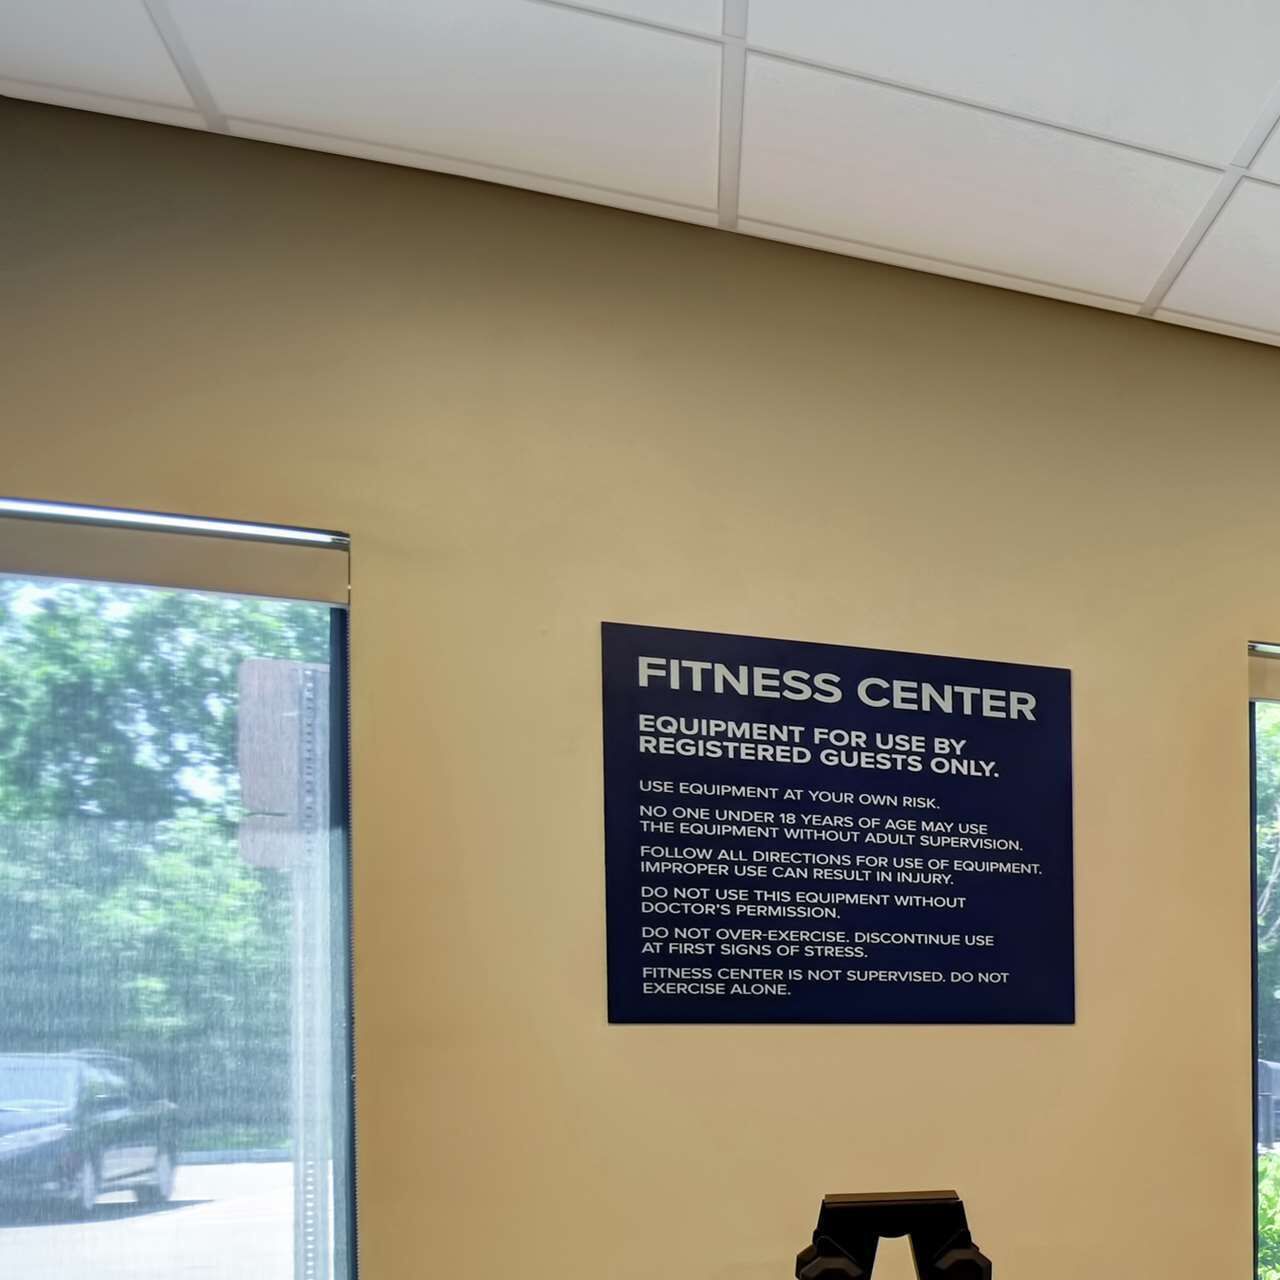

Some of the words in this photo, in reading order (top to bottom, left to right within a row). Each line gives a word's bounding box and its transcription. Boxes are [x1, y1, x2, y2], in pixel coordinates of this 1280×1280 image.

[638, 655, 842, 703] FITNESS
[857, 677, 1036, 720] CENTER
[638, 713, 805, 742] EQUIPMENT
[813, 727, 866, 747] FOR
[875, 732, 925, 752] USE
[933, 737, 966, 755] BY
[639, 735, 811, 763] REGISTERED
[819, 748, 922, 771] GUESTS
[930, 757, 999, 777] ONLY.
[639, 779, 673, 792] USE
[679, 782, 779, 799] EQUIPMENT
[783, 788, 803, 800] AT
[807, 790, 854, 803] YOUR
[858, 793, 897, 806] OWN
[902, 796, 939, 808] RISK.
[639, 804, 667, 817] NO
[672, 806, 709, 819] ONE
[715, 809, 774, 823] UNDER
[778, 812, 795, 824] 18
[800, 813, 853, 827] YEARS
[857, 817, 880, 828] OF
[884, 818, 916, 831] AGE
[921, 820, 953, 832] MAY
[958, 823, 987, 834] USE
[639, 820, 674, 833] THE
[679, 822, 779, 837] EQUIPMENT
[783, 827, 860, 842] WITHOUT
[864, 832, 915, 845] ADULT
[919, 834, 1022, 850] SUPERVISION.
[640, 845, 712, 859] FOLLOW
[717, 849, 747, 861] ALL
[752, 850, 851, 865] DIRECTIONS
[855, 855, 888, 867] FOR
[892, 857, 923, 869] USE
[927, 858, 949, 869] OF
[953, 859, 1042, 874] EQUIPMENT.
[640, 861, 728, 875] IMPROPER
[734, 864, 767, 877] USE
[772, 866, 807, 878] CAN
[813, 867, 871, 881] RESULT
[876, 870, 892, 881] IN
[897, 871, 953, 884] INJURY.
[641, 886, 668, 898] DO
[673, 887, 710, 899] NOT
[715, 888, 748, 900] USE
[753, 889, 791, 902] THIS
[795, 891, 890, 905] EQUIPMENT
[893, 894, 966, 907] WITHOUT
[641, 901, 730, 915] DOCTOR'S
[736, 904, 840, 918] PERMISSION.
[642, 926, 668, 938] DO
[674, 927, 711, 939] NOT
[715, 928, 849, 942] OVER-EXERCISE.
[854, 931, 960, 945] DISCONTINUE
[964, 934, 994, 945] USE
[641, 942, 663, 953] AT
[668, 942, 715, 954] FIRST
[720, 943, 771, 955] SIGNS
[776, 944, 799, 956] OF
[804, 945, 867, 957] STRESS.
[642, 966, 712, 979] FITNESS
[717, 968, 783, 979] CENTER
[788, 969, 802, 980] IS
[807, 969, 842, 980] NOT
[846, 969, 945, 982] SUPERVISED.
[950, 971, 973, 982] DO
[977, 972, 1009, 983] NOT
[643, 982, 725, 994] EXERCISE
[730, 983, 790, 994] ALONE.
